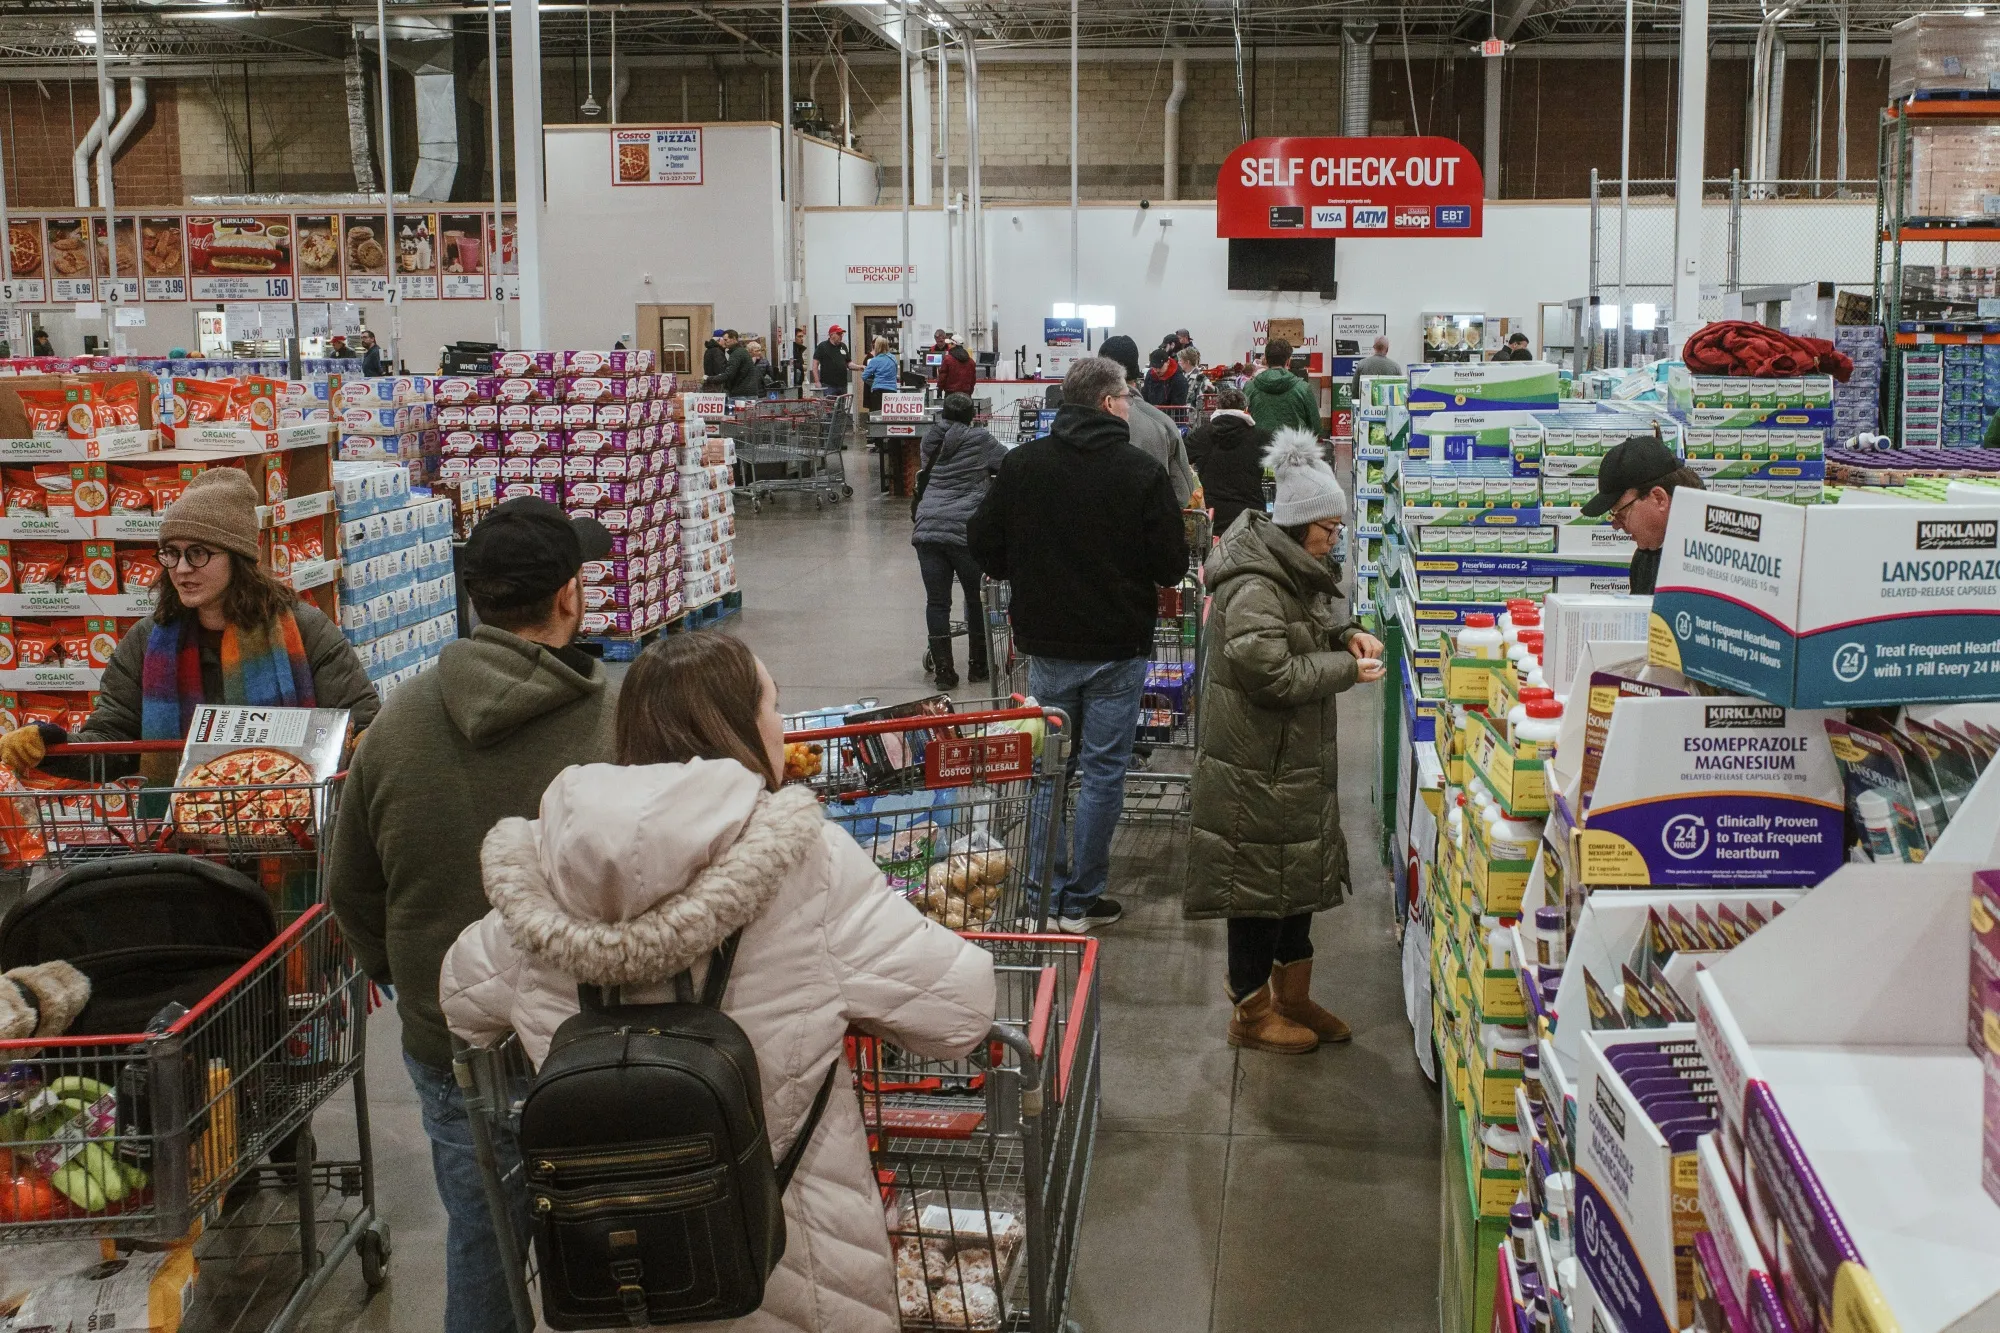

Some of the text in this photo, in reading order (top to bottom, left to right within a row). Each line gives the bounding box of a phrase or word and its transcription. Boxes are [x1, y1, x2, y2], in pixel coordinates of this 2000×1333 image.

[1486, 42, 1501, 54] EXIT
[1240, 157, 1460, 186] SELF CHECK-OUT
[1317, 212, 1342, 222] VISA
[1355, 211, 1386, 223] ATM
[1395, 214, 1430, 228] shop
[1442, 211, 1463, 220] EBT
[4, 286, 12, 298] 5
[76, 284, 91, 294] 6.99
[165, 280, 184, 293] 3.99
[266, 278, 288, 297] 1.50
[326, 283, 338, 291] 7.99
[110, 289, 118, 301] 6
[388, 290, 395, 302] 7
[496, 288, 504, 300] 8
[899, 303, 913, 317] 10
[242, 329, 260, 339] 31.99
[276, 328, 294, 338] 31.99
[312, 327, 328, 336] 49.99
[345, 325, 361, 334] 39.99
[697, 403, 723, 413] OSED
[884, 403, 922, 413] CLOSED
[1708, 507, 1760, 532] KIRKLAND
[1708, 521, 1757, 538] Signature
[1921, 523, 1996, 539] KIRKLAND
[1921, 536, 1995, 549] Signature
[1684, 538, 1782, 579] LANSOPRAZOLE
[1682, 562, 1729, 582] DELAYED-RELEASE
[1730, 573, 1758, 589] CAPSULES
[1760, 581, 1767, 590] 15
[1881, 585, 1997, 598] DELAYED-RELEASE CAPSULES
[1679, 618, 1689, 630] 24
[1695, 616, 1780, 651] Treat Frequent Heartburn
[1695, 632, 1780, 669] with 1 Pill Every 24 Hours
[1875, 643, 1906, 658] Treat
[1908, 643, 1963, 660] Frequent
[1842, 652, 1859, 666] 24
[1874, 661, 1988, 679] with 1 Pill Every 24
[1621, 681, 1660, 697] KIRKLAND
[250, 712, 268, 722] 2
[1709, 707, 1782, 719] KIRKLAND
[196, 709, 212, 742] KIRKLAND
[214, 710, 230, 742] SUPREME
[231, 710, 249, 742] Cauliflower
[1709, 719, 1782, 728] Signature
[243, 727, 257, 743] Crust
[256, 729, 269, 743] Pizza
[1684, 737, 1808, 752] ESOMEPRAZOLE
[1695, 755, 1795, 770] MAGNESIUM
[939, 767, 971, 777] COSTCO
[1716, 815, 1818, 830] Clinically Proven
[1675, 825, 1696, 841] 24
[1717, 832, 1822, 847] to Treat Frequent
[1716, 848, 1779, 860] Heartburn
